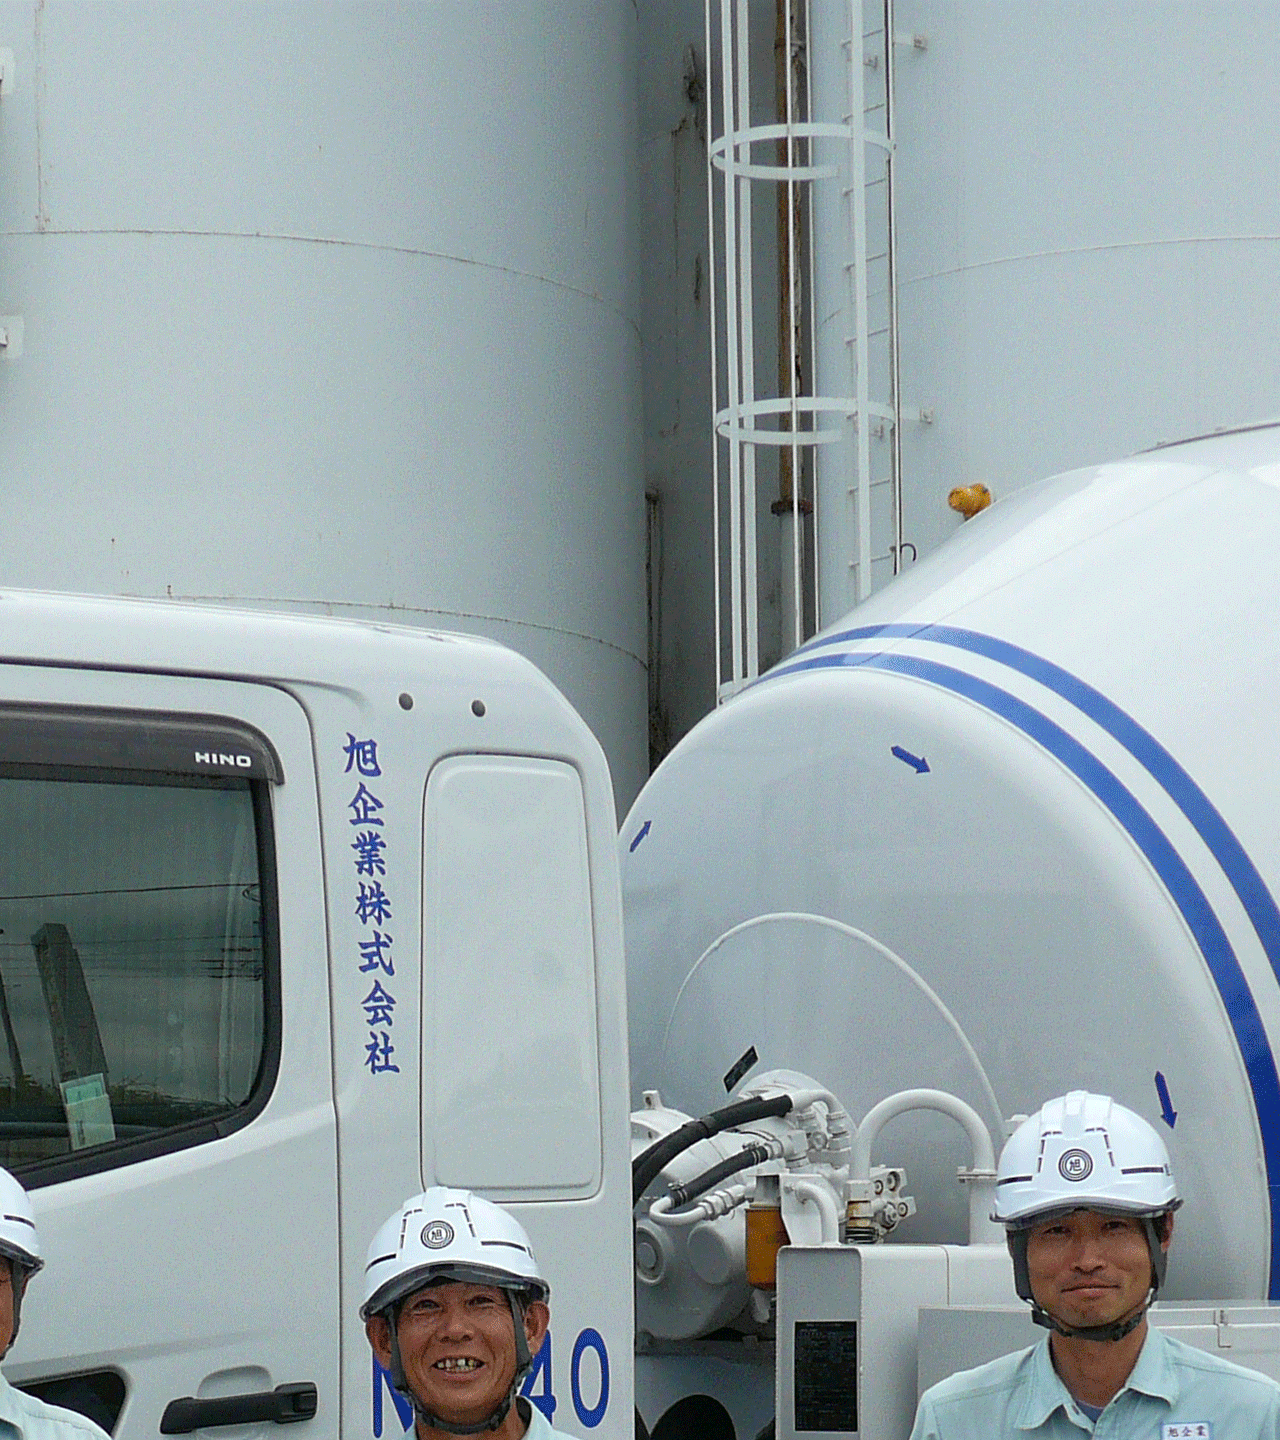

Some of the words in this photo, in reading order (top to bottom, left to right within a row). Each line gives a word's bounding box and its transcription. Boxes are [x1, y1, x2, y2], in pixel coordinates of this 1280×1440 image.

[194, 751, 252, 768] HINO
[342, 732, 401, 1076] 旭企業株式会社
